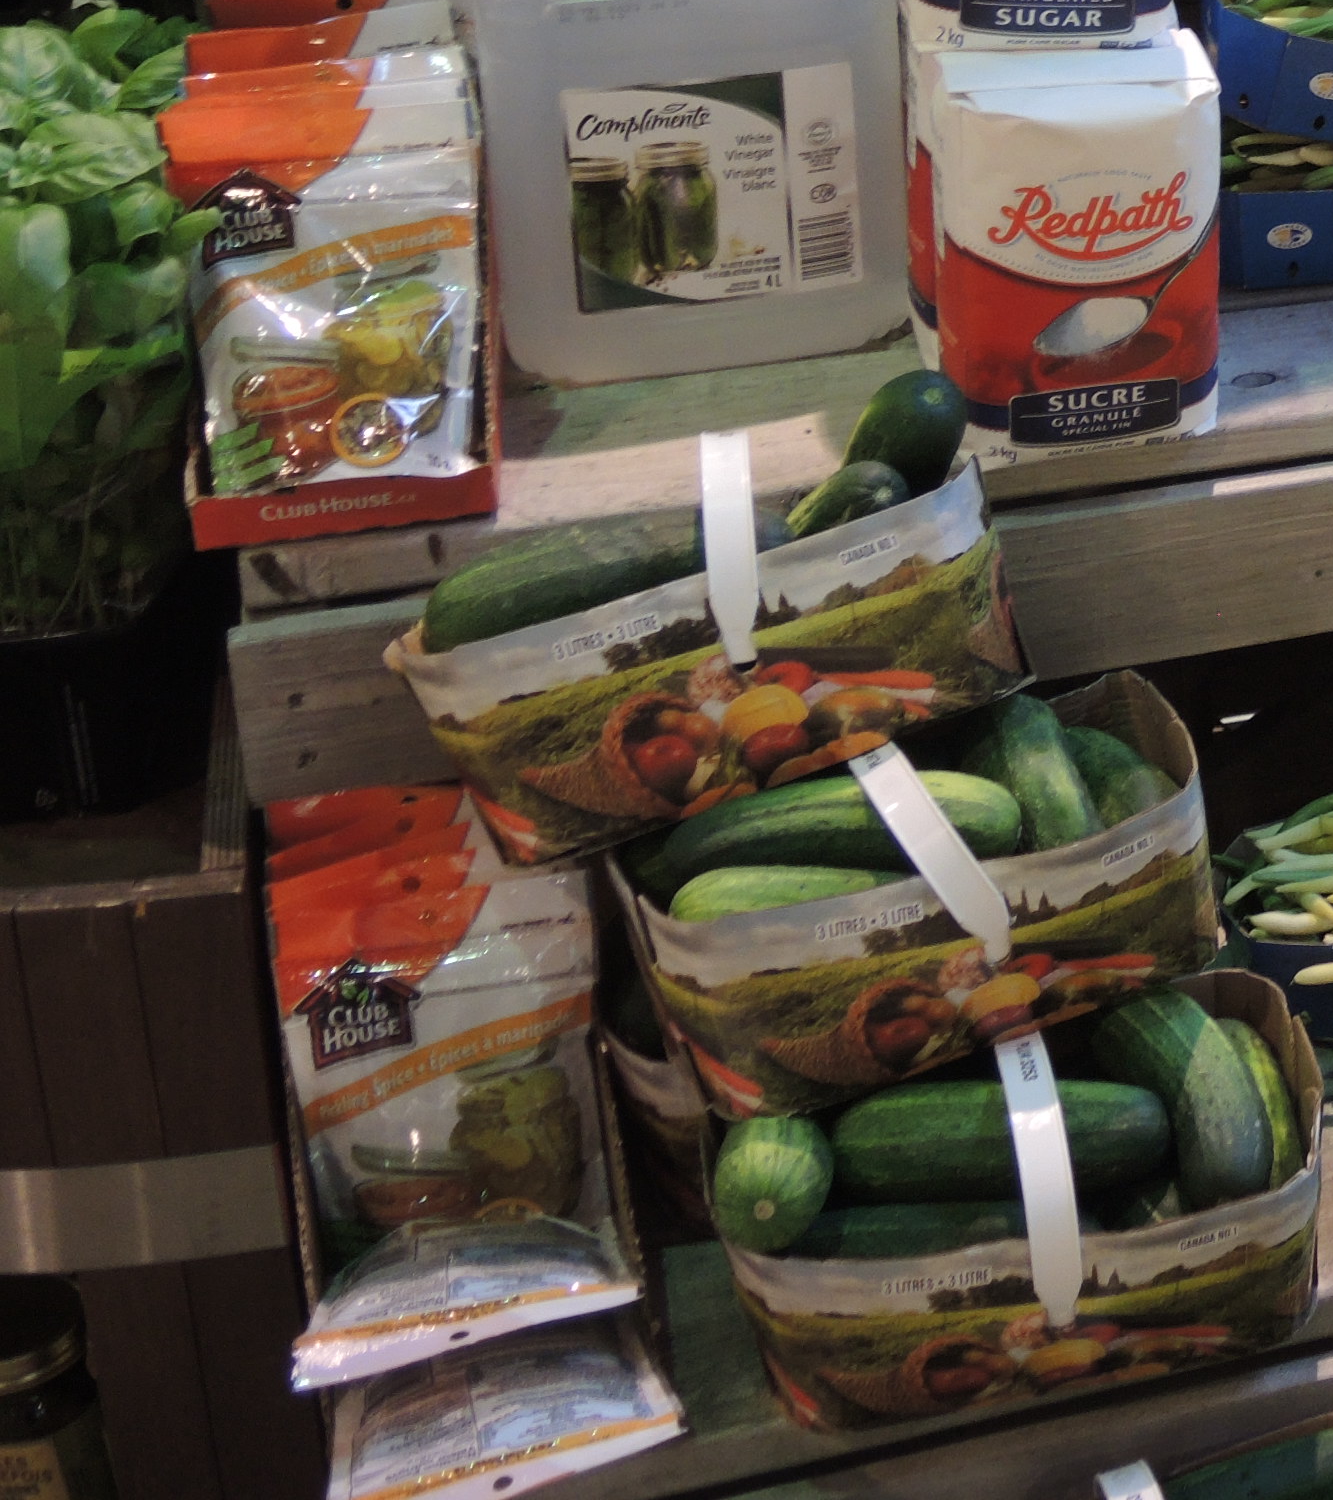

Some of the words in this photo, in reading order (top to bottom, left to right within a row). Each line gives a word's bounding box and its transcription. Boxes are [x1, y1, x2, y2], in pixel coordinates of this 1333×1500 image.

[995, 8, 1103, 28] SUGAR
[935, 25, 946, 42] 2
[948, 28, 964, 48] kg
[576, 103, 711, 142] Compliments
[735, 132, 774, 147] White
[724, 147, 774, 162] Vinegar
[722, 165, 776, 181] Vinaigre
[742, 178, 777, 193] blanc
[220, 208, 275, 231] CLUB
[988, 171, 1194, 261] Redpath
[213, 224, 287, 253] HOUSE
[1047, 384, 1147, 412] SUCRE
[1051, 407, 1142, 428] GRANULÉ
[555, 643, 564, 660] 3
[566, 632, 604, 658] LITRES
[625, 615, 658, 639] LITRE
[1103, 843, 1136, 867] CANADA
[816, 924, 825, 941] 3
[828, 914, 867, 939] LITRES
[879, 911, 888, 927] 3
[889, 903, 922, 925] LITRE
[326, 1000, 391, 1030] CLUB
[321, 1017, 401, 1054] HOUSE
[883, 1280, 892, 1295] 3
[894, 1274, 935, 1294] LITRES
[959, 1268, 990, 1287] LITRE
